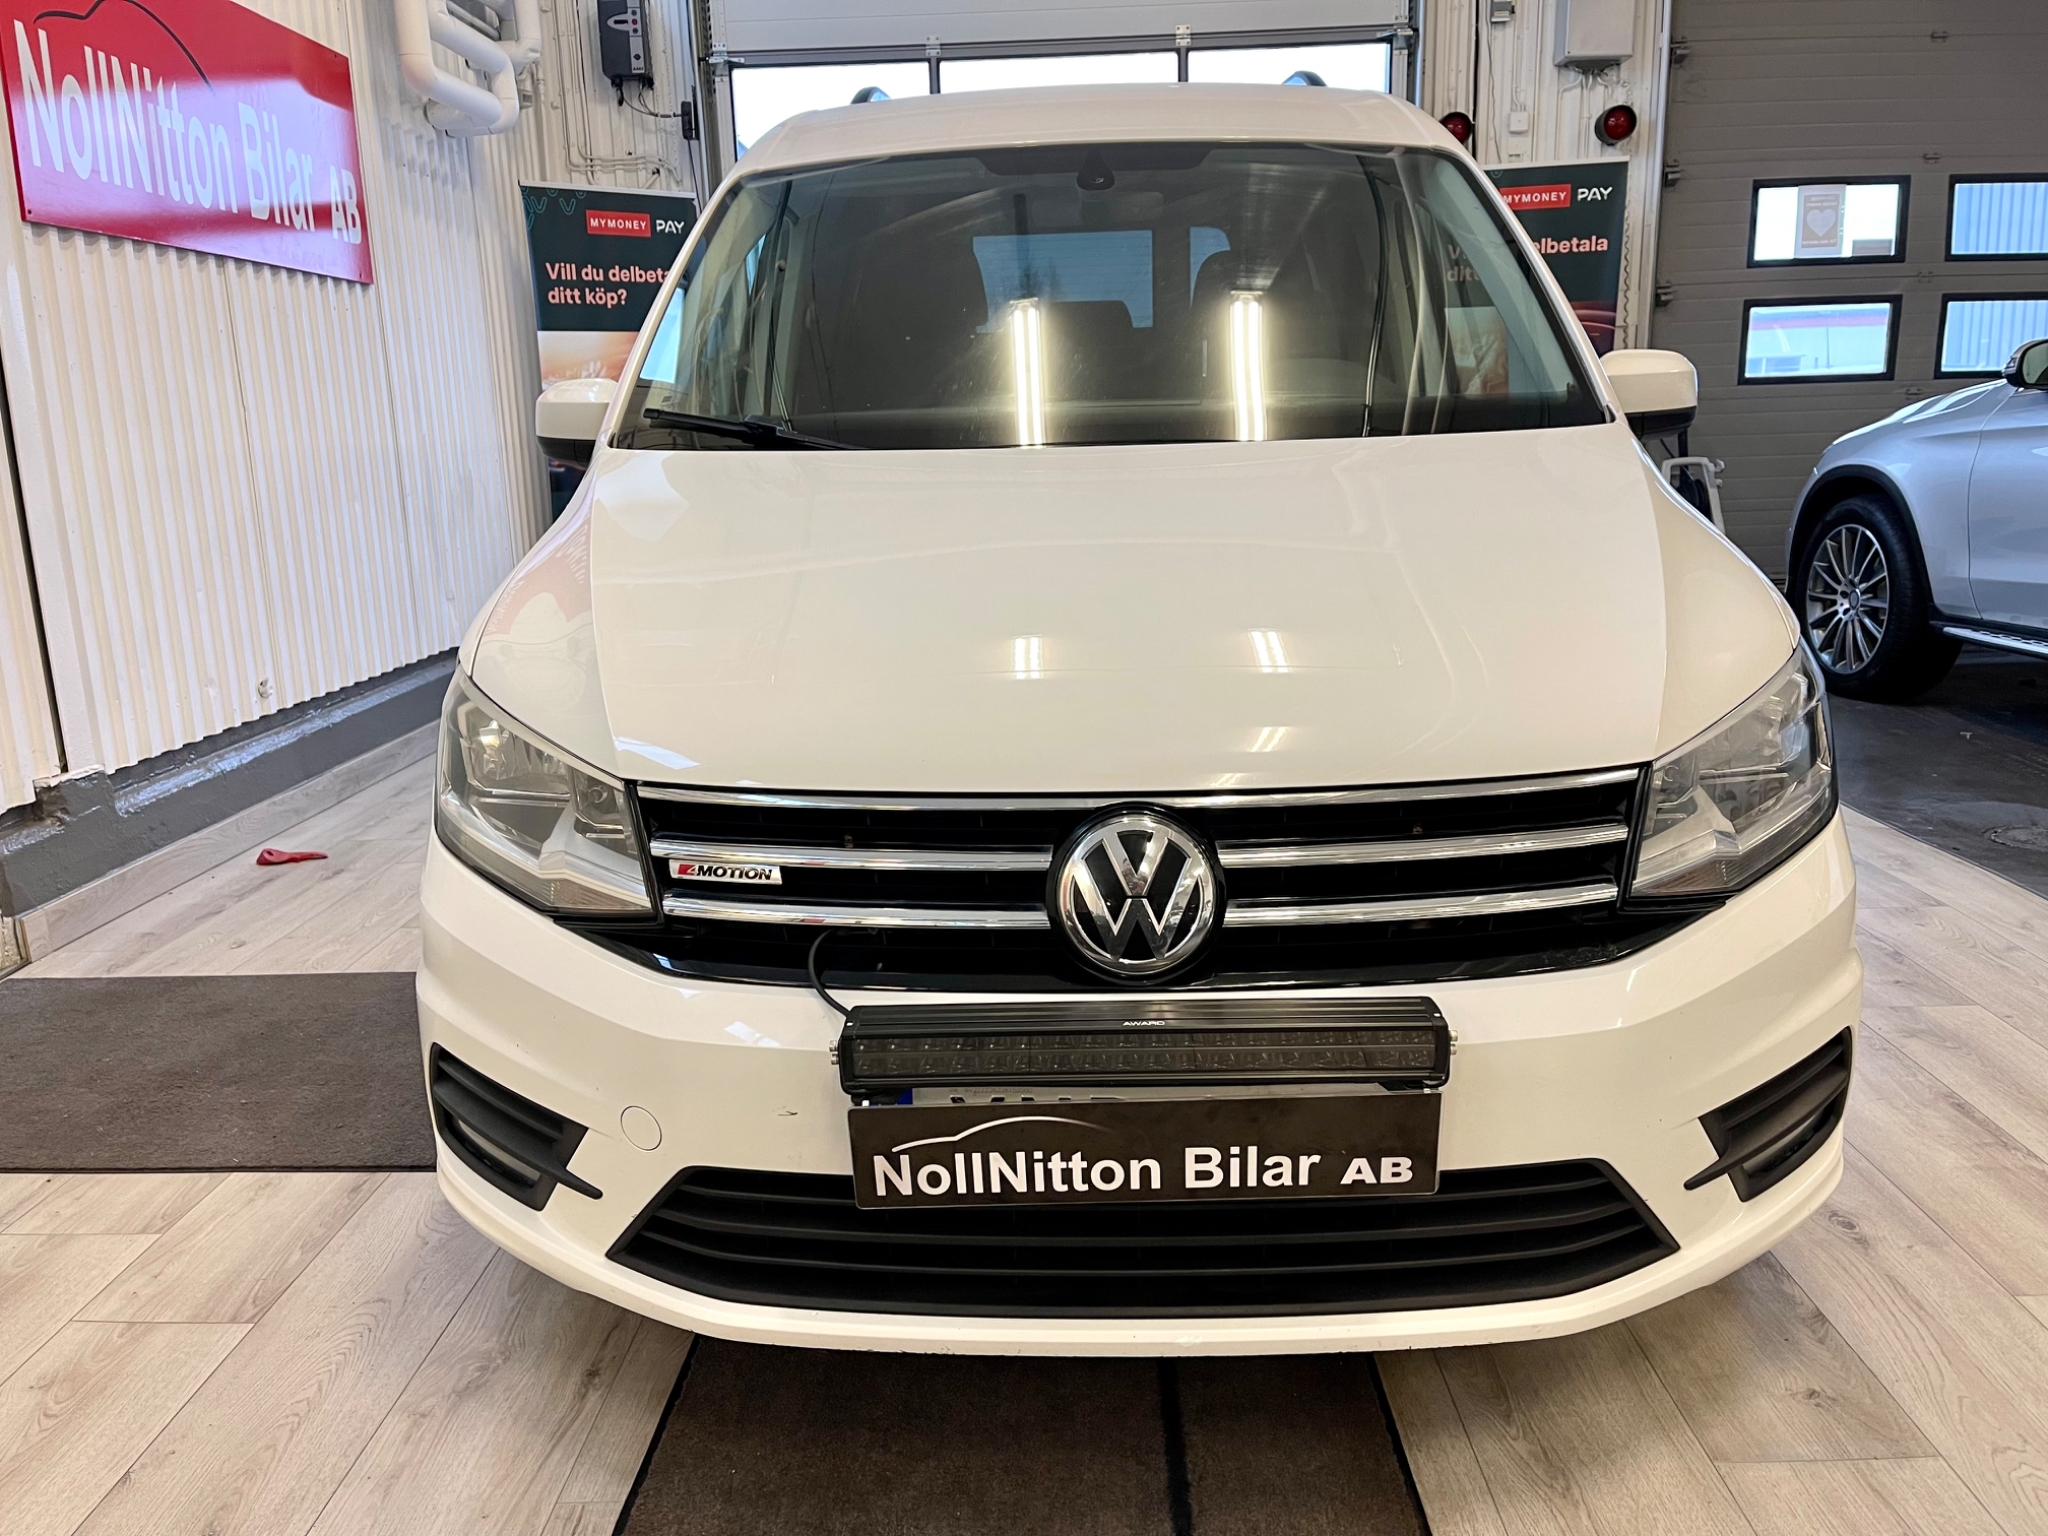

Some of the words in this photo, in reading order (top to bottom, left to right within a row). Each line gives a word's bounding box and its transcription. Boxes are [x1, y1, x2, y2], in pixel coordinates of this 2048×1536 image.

[13, 19, 239, 214] NollNitton
[238, 101, 316, 232] Bilar
[329, 164, 363, 245] AB
[1577, 187, 1612, 201] PAY
[590, 217, 647, 230] MYMONEY
[655, 219, 685, 234] PAY
[545, 262, 577, 280] Vill
[581, 265, 604, 281] du
[548, 287, 581, 304] ditt
[585, 287, 628, 309] köp?
[873, 1150, 1162, 1197] NollNitton
[1184, 1145, 1321, 1189] Bilar
[1340, 1156, 1413, 1185] AB
